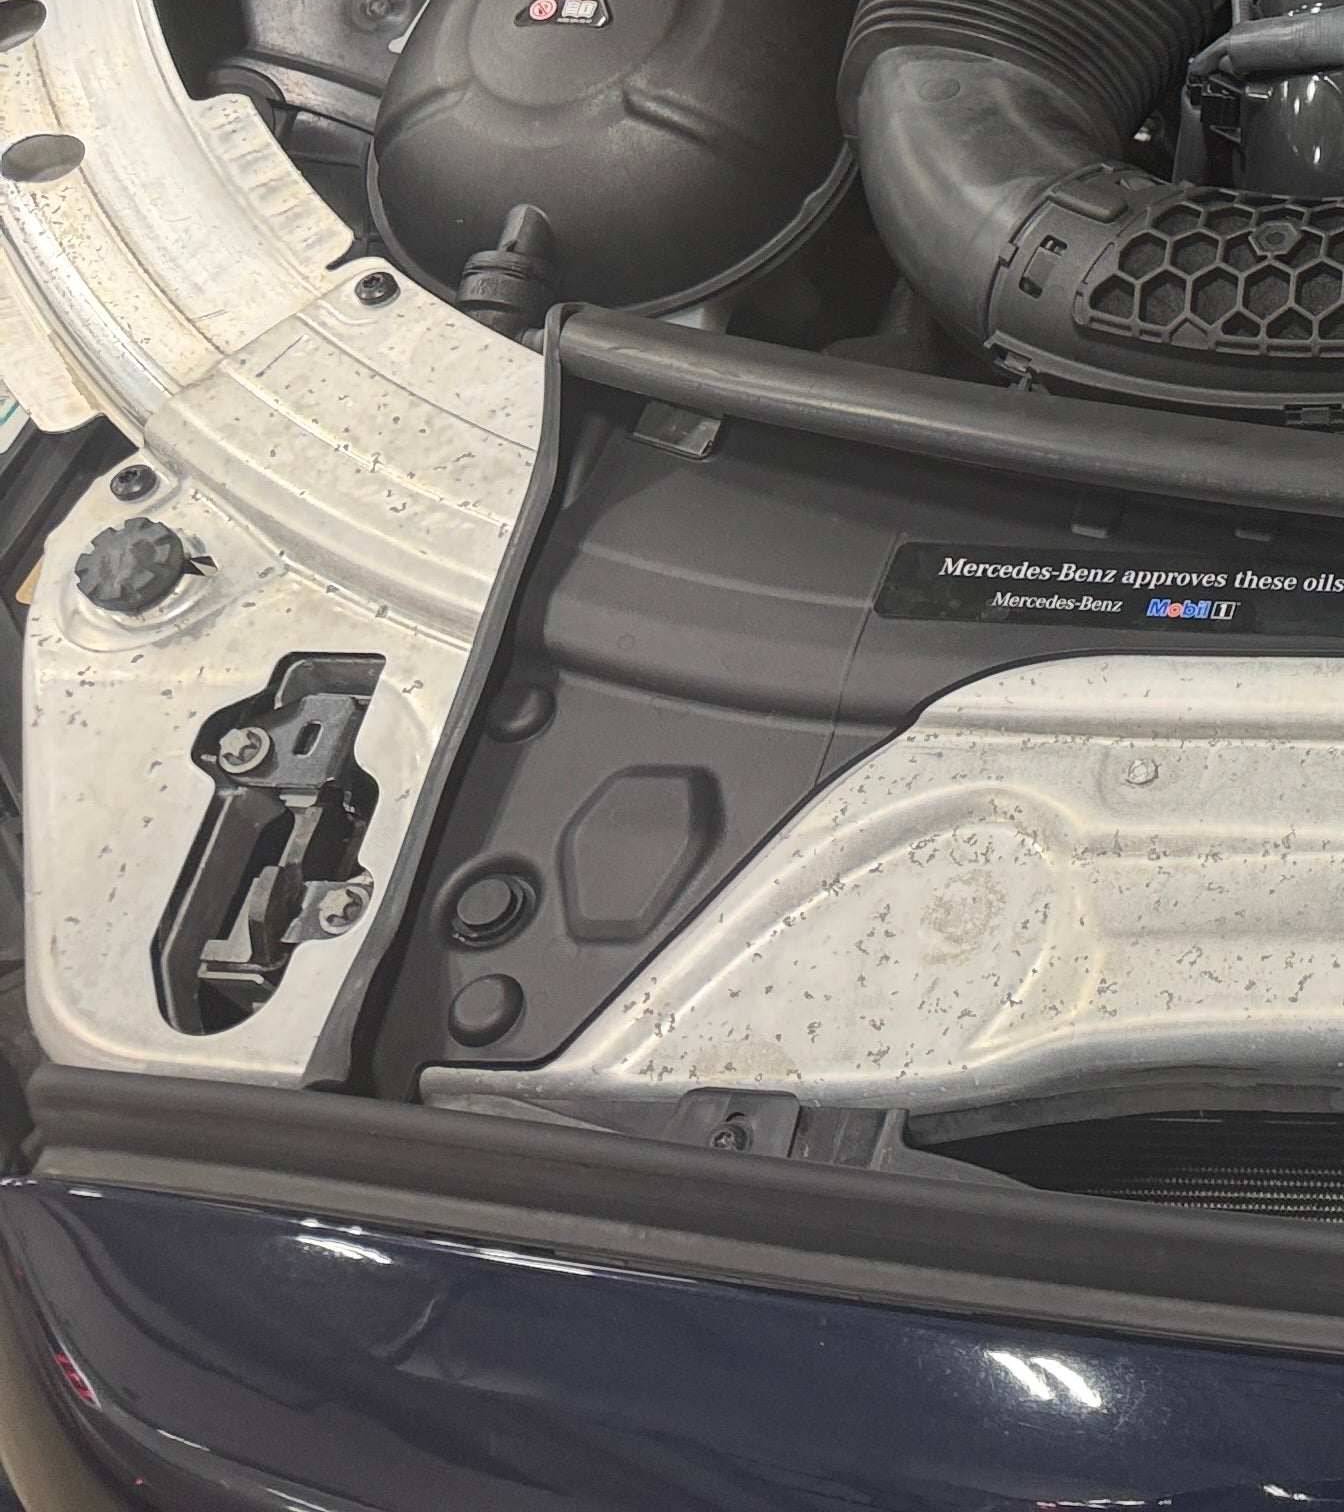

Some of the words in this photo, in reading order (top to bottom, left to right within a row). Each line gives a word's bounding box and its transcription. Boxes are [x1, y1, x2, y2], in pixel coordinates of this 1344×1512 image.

[938, 557, 1118, 583] Mercedes-Benz
[1121, 568, 1229, 589] approves
[1234, 570, 1298, 591] these
[990, 591, 1124, 613] Mercedes-Benz
[1146, 598, 1212, 619] Mobil
